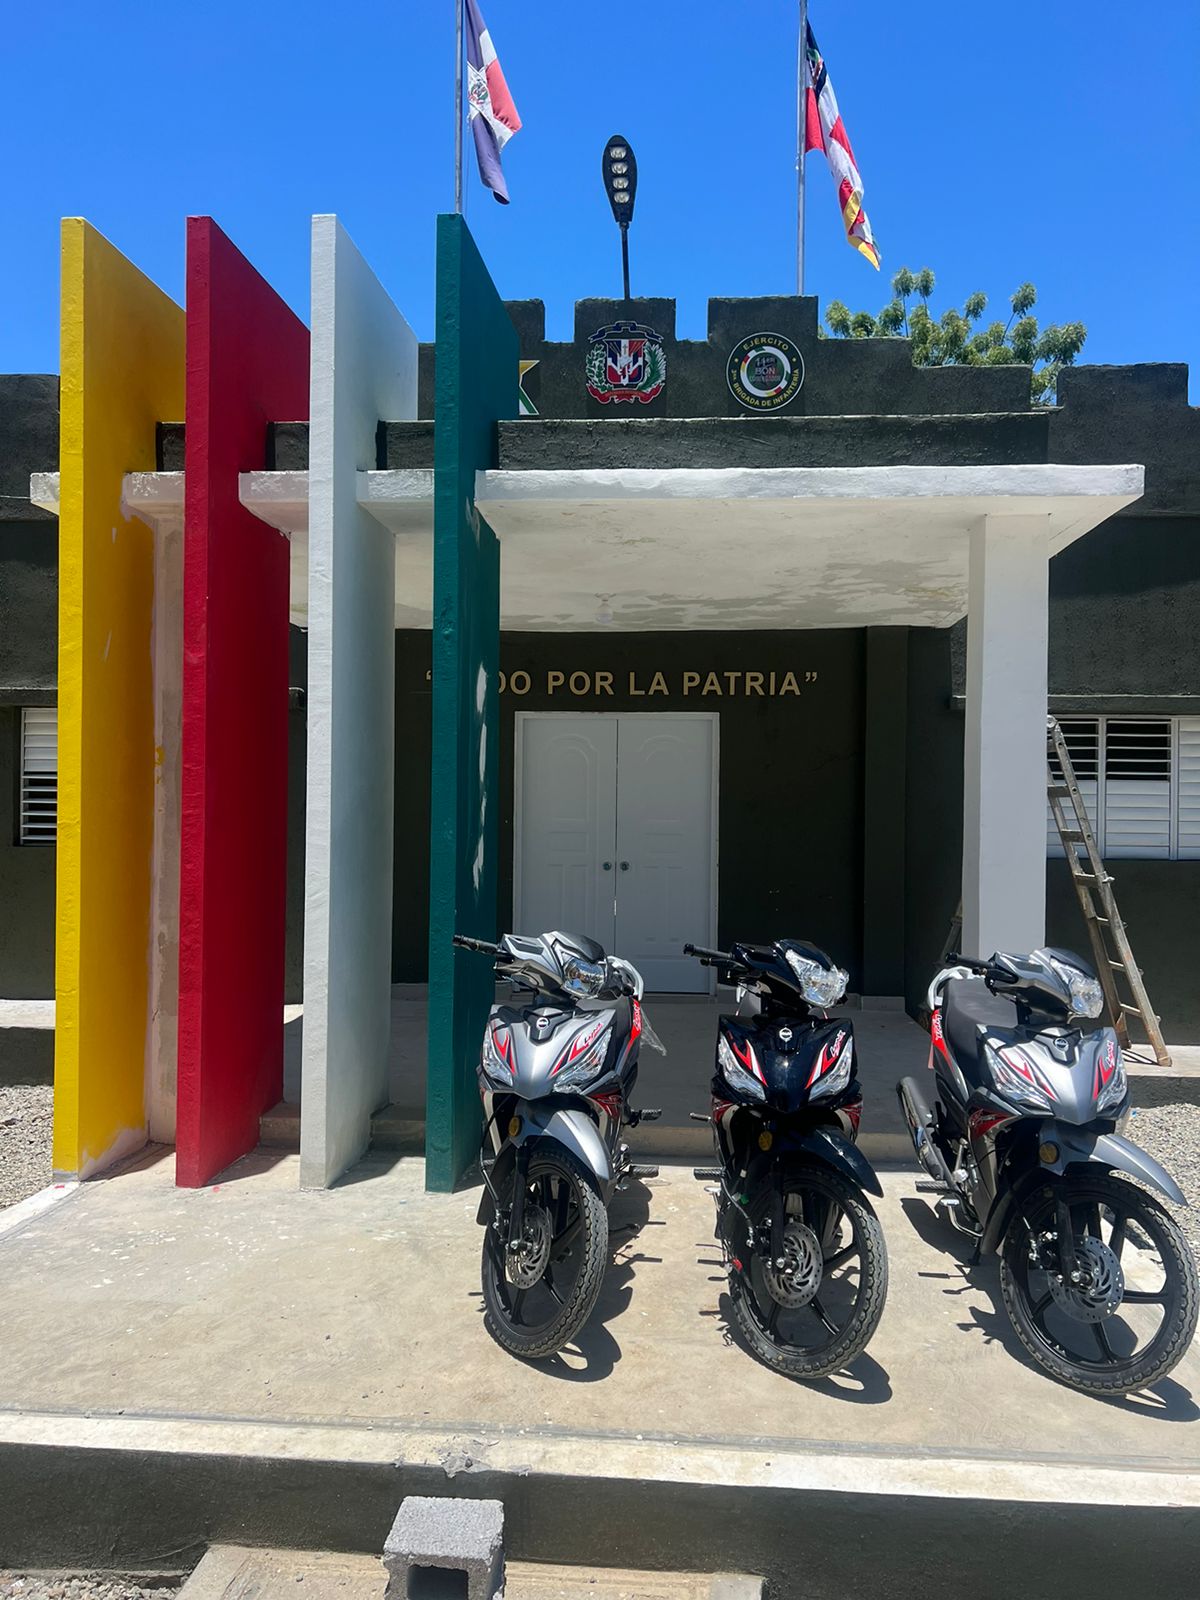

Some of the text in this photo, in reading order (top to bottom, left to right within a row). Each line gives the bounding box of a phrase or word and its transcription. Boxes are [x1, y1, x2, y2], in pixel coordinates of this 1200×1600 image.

[733, 382, 759, 405] BRIGADA
[547, 671, 614, 696] POR
[629, 671, 669, 696] LA
